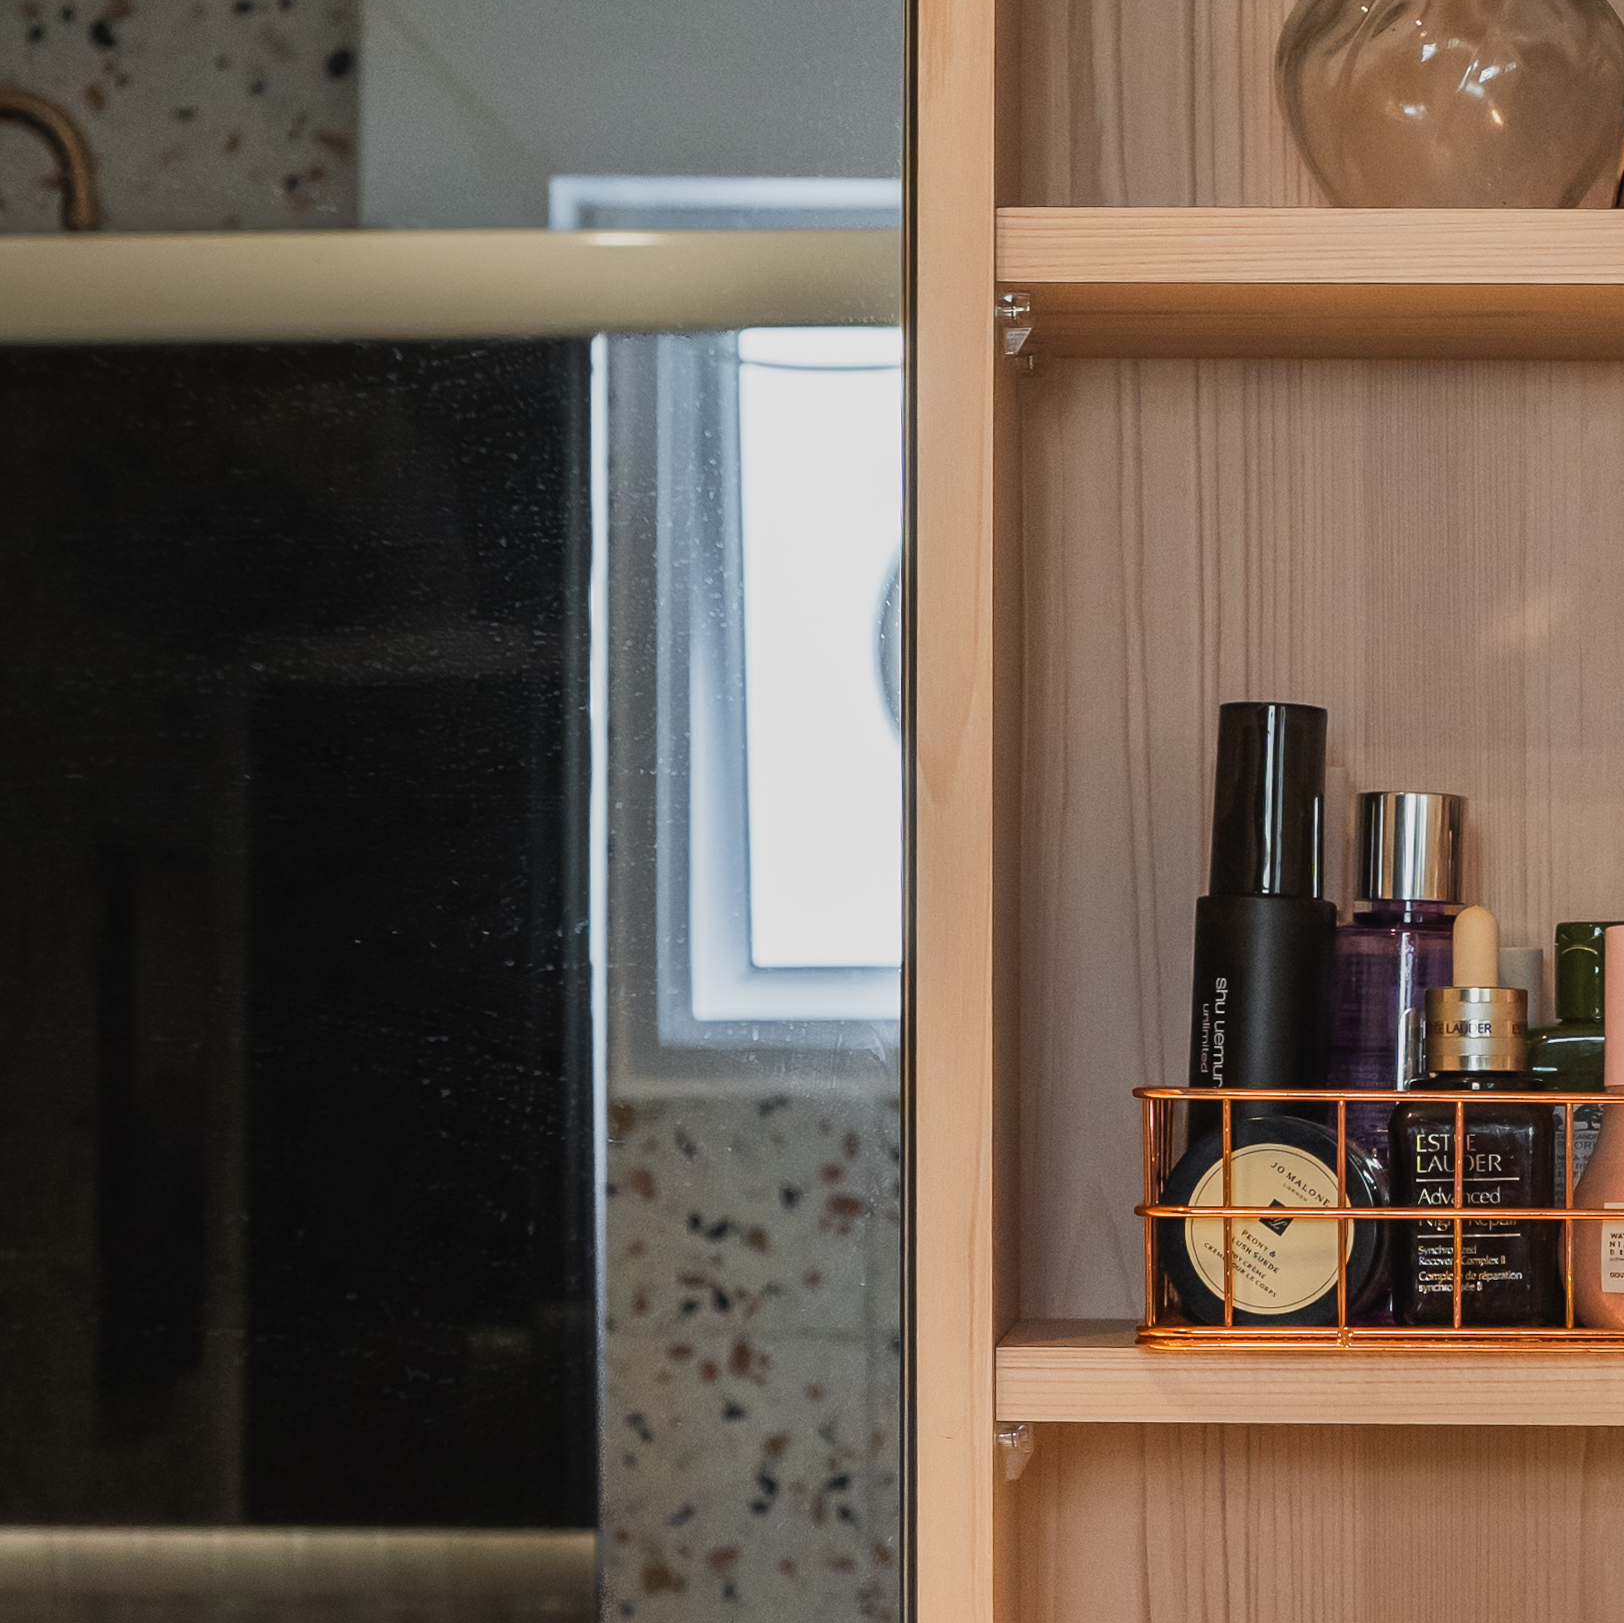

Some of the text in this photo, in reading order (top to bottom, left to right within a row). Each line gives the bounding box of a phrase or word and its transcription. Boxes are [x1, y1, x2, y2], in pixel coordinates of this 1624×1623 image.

[1200, 1003, 1210, 1073] unlimited
[1212, 977, 1228, 1089] shu uemur
[1446, 1023, 1492, 1034] LAUDER
[1416, 1134, 1476, 1152] ESTE
[1270, 1162, 1331, 1207] JO MALONE
[1241, 1229, 1269, 1252] PEONY
[1418, 1244, 1477, 1255] Synchrozed
[1253, 1251, 1280, 1274] SUEDE
[1418, 1256, 1455, 1266] Recover
[1461, 1255, 1499, 1266] Complex
[1231, 1262, 1245, 1275] OUR
[1255, 1279, 1277, 1298] CORPS
[1418, 1270, 1463, 1284] Comple
[1465, 1270, 1477, 1280] de
